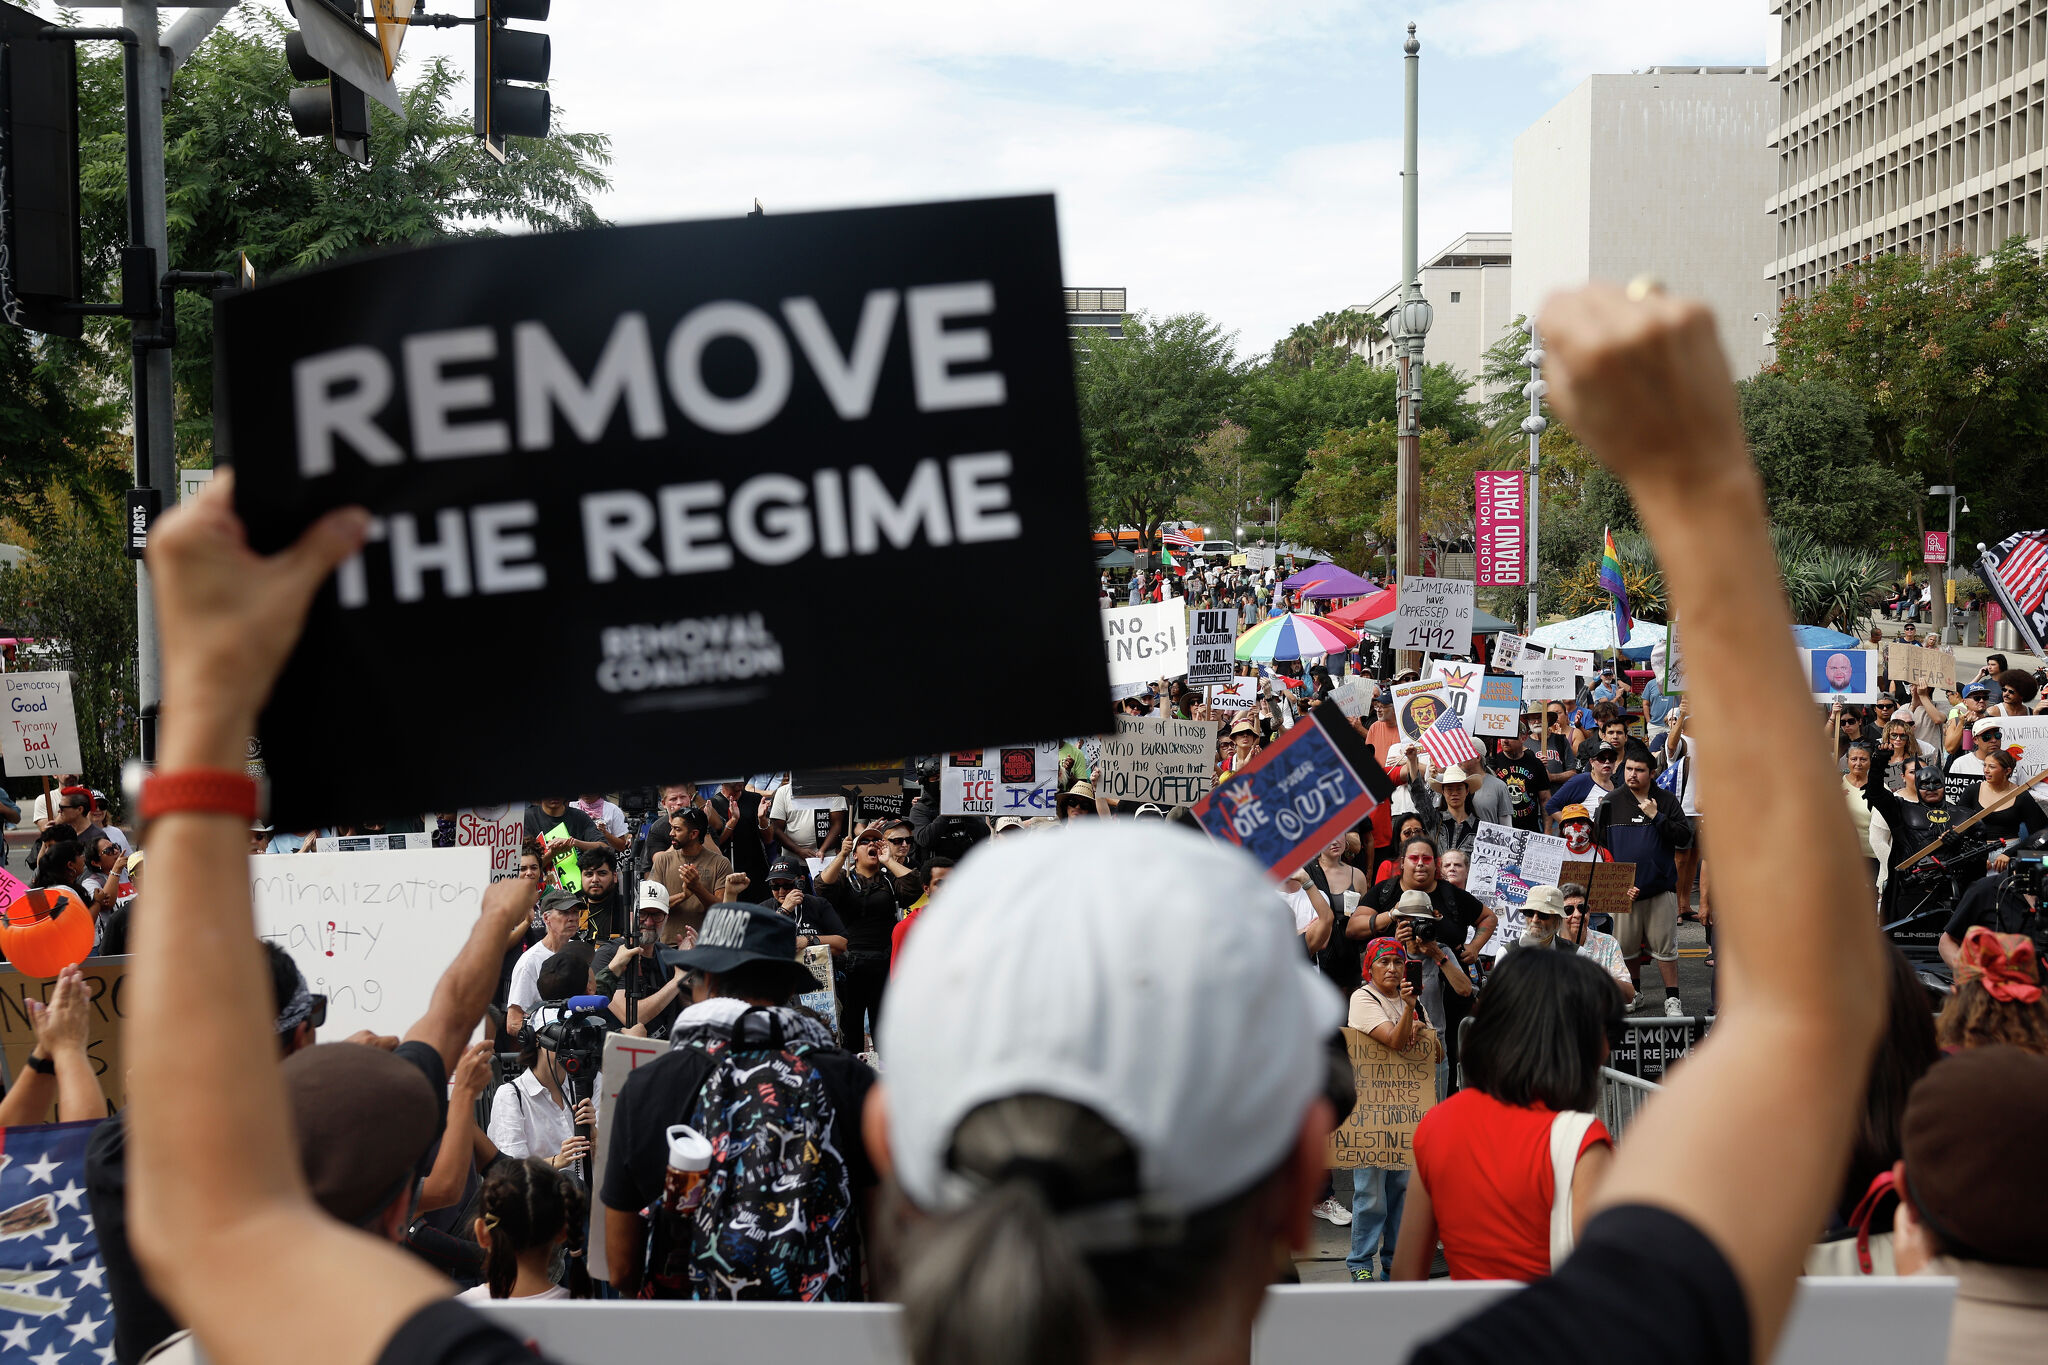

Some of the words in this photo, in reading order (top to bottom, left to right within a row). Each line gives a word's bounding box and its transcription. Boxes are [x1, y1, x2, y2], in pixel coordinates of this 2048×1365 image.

[292, 281, 1006, 479] REMOVE
[1480, 475, 1491, 526] MOLINA
[1493, 474, 1520, 520] PARK
[336, 501, 546, 608] THE
[581, 451, 1022, 583] REGIME
[1481, 533, 1491, 583] GLORIA
[1494, 525, 1520, 583] GRAND
[1412, 578, 1474, 597] IMMIGRANTS
[1425, 595, 1445, 605] have
[1400, 603, 1449, 619] OPPRESSED
[1455, 607, 1469, 619] US
[1108, 617, 1143, 637] NO
[1197, 611, 1229, 635] FULL
[1419, 619, 1445, 628] since
[601, 611, 773, 660] REMOVAL
[1192, 633, 1232, 646] LEGALIZATION
[1405, 626, 1455, 650] 1492
[1104, 626, 1177, 664] INGS!
[1195, 649, 1212, 664] FOR
[1213, 648, 1227, 663] ALL
[597, 642, 784, 693] COALITION
[1189, 663, 1232, 677] IMMIGRANTS
[1542, 669, 1560, 677] Trump
[1912, 668, 1945, 685] FEAR
[6, 679, 61, 694] Democracy
[1396, 689, 1409, 697] NO
[1410, 681, 1443, 693] CROWN
[1485, 688, 1515, 696] JAMES
[1486, 681, 1512, 689] HANG
[11, 695, 48, 713] Good
[1222, 699, 1254, 708] KINGS
[1482, 713, 1511, 723] FUCK
[1487, 721, 1505, 730] ICE
[12, 720, 58, 737] Tyranny
[1118, 720, 1145, 736] ome
[1155, 720, 1167, 737] of
[23, 734, 51, 752] Bad
[1004, 768, 1032, 777] CHILDREN
[1131, 759, 1149, 772] the
[1187, 762, 1208, 774] that
[1509, 765, 1534, 780] KINGS
[962, 769, 976, 782] THE
[977, 769, 995, 781] POL-
[962, 780, 994, 802] ICE
[1103, 770, 1150, 799] HOLD
[1149, 775, 1212, 804] OFFICE
[1945, 786, 1965, 795] CON
[863, 795, 904, 808] CONVICT
[1003, 787, 1058, 809] ICE
[1275, 768, 1346, 841] OUT
[863, 803, 901, 815] REMOVE
[962, 801, 993, 813] KILLS!
[816, 812, 830, 820] IMPE
[458, 813, 523, 848] Stephen
[817, 821, 830, 829] CON
[1530, 832, 1546, 843] VOTE
[1546, 838, 1556, 846] AS
[490, 845, 517, 871] ler:
[250, 872, 479, 912] minalization
[647, 885, 658, 898] LA
[1508, 885, 1529, 896] VOTE
[260, 918, 384, 961] tality
[315, 976, 383, 1013] ing
[800, 993, 818, 1001] VOTE
[1620, 1027, 1695, 1044] EMOVE
[1613, 1049, 1637, 1061] THE
[1355, 1080, 1367, 1088] CE
[1366, 1088, 1420, 1104] WARS
[1359, 1103, 1374, 1111] ICE
[1350, 1111, 1369, 1128] OP
[1335, 1150, 1407, 1164] GENOCIDE
[744, 1226, 767, 1242] AIR
